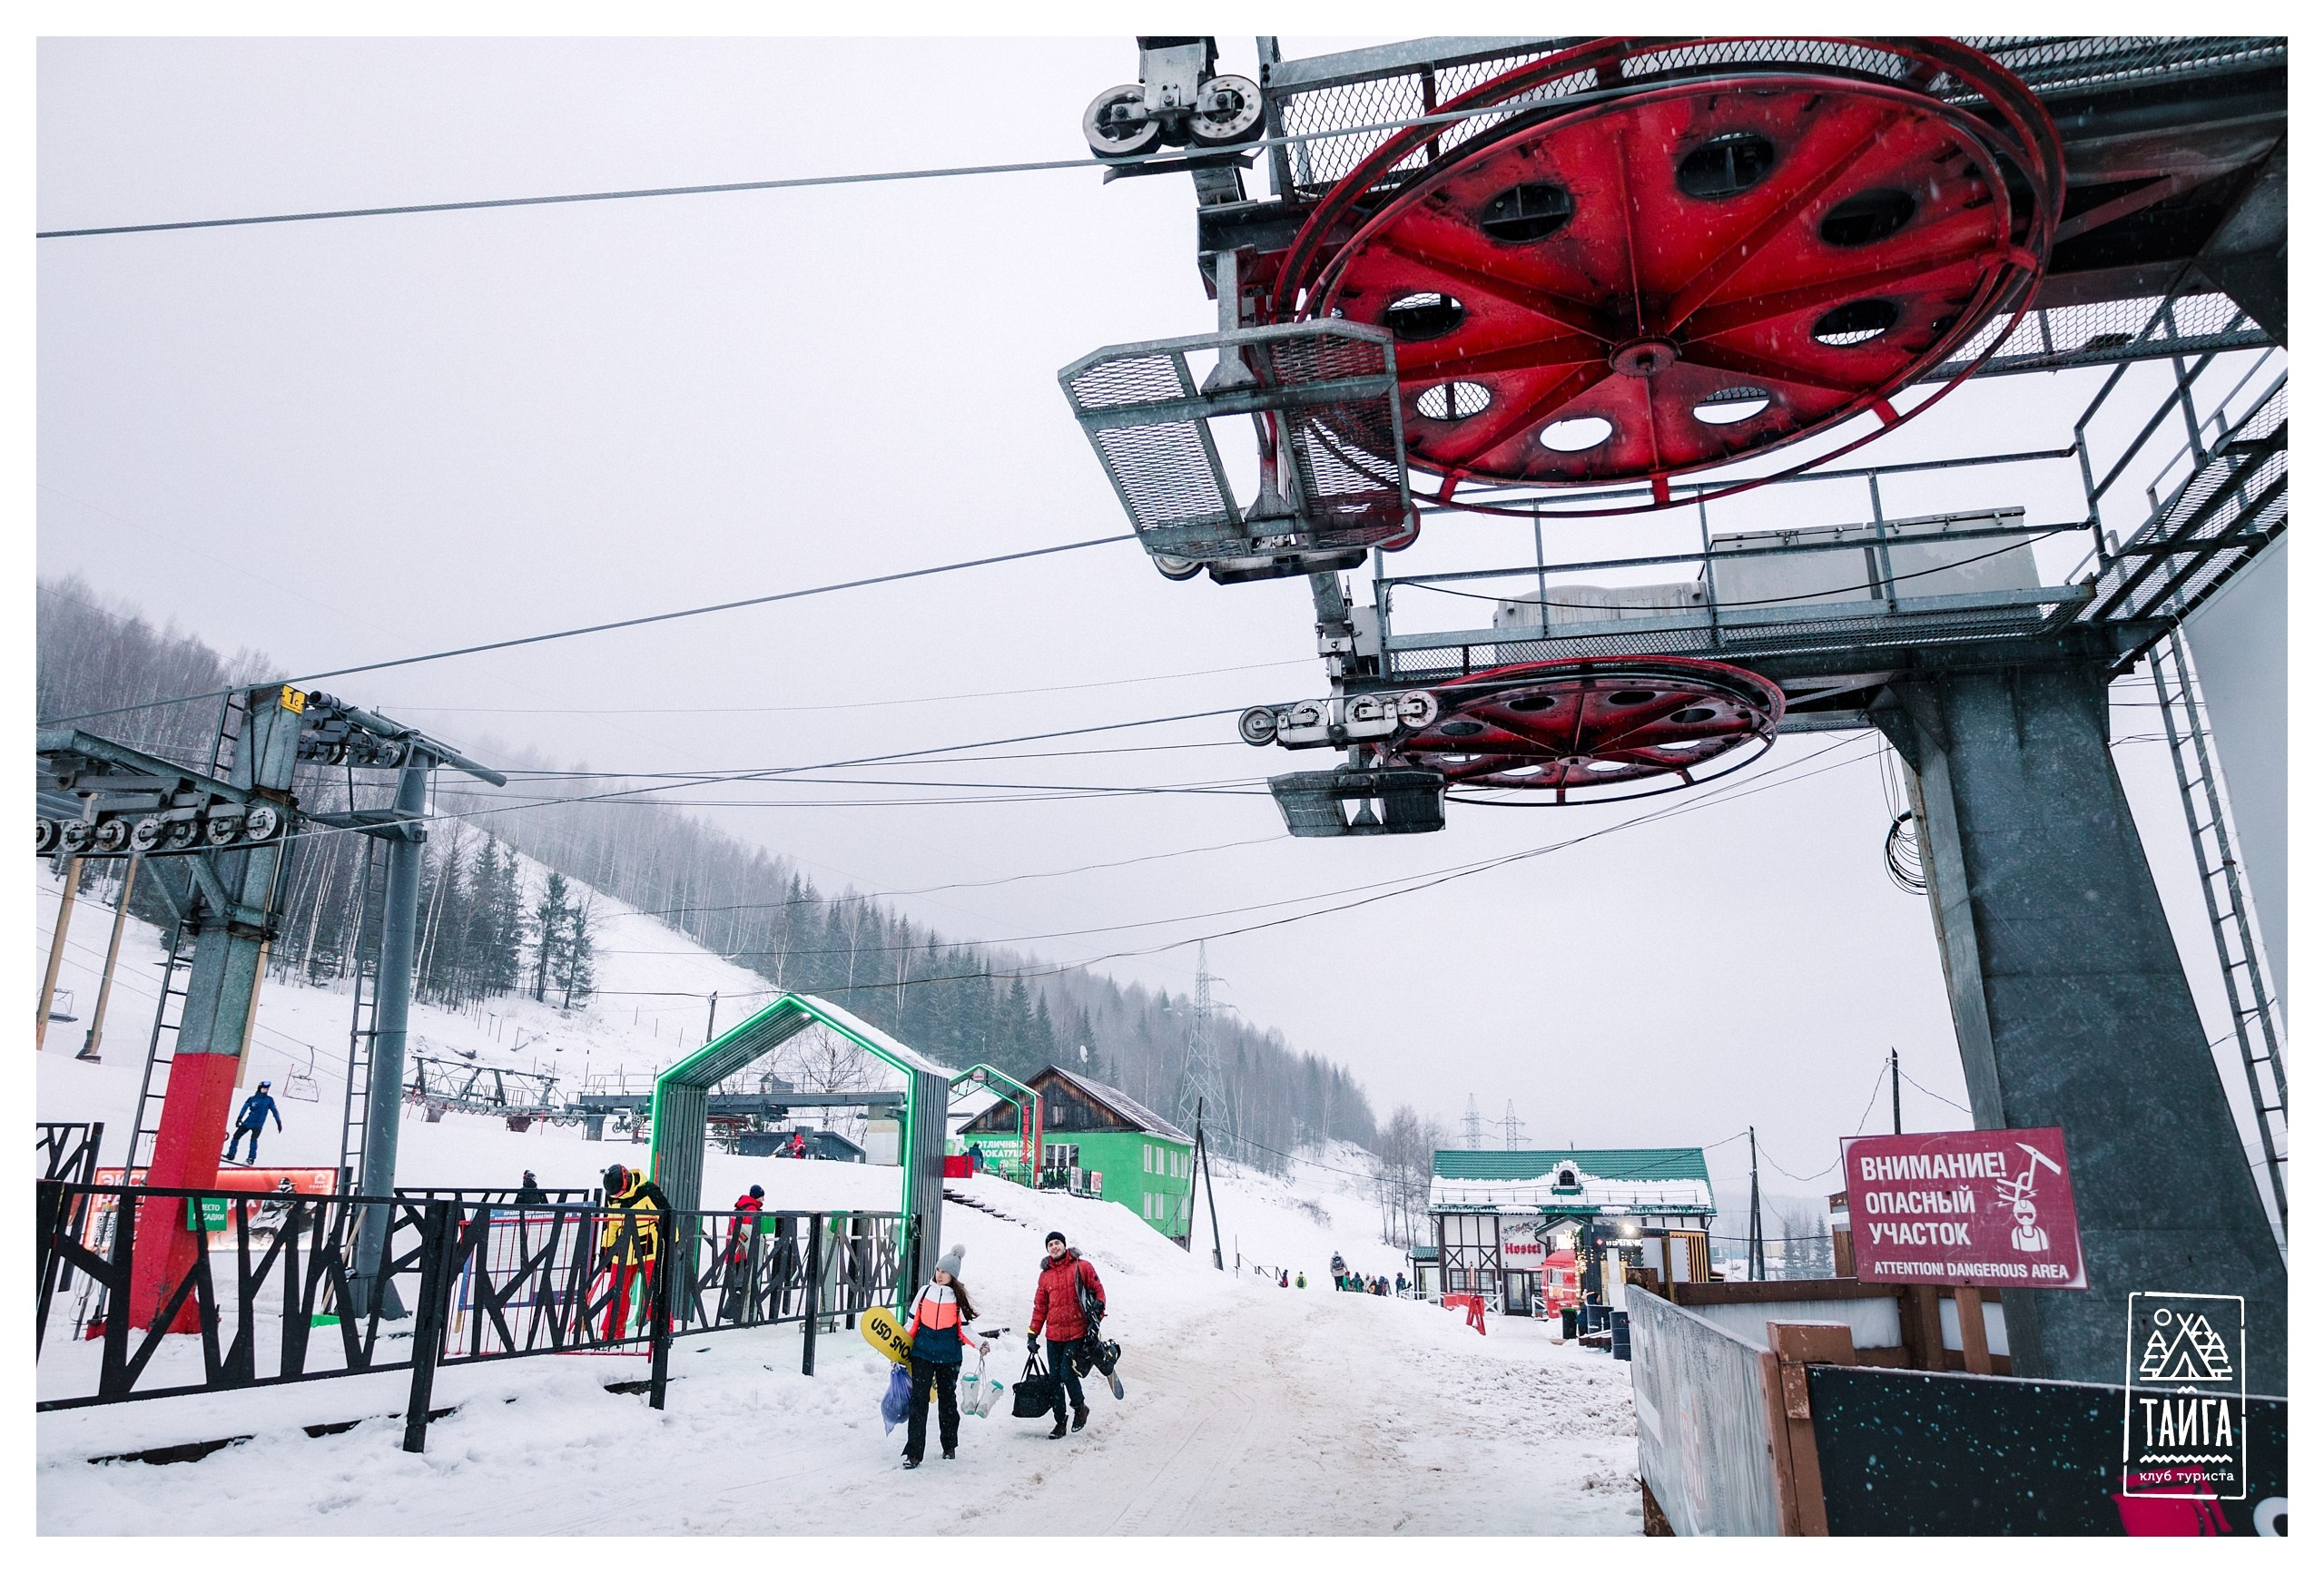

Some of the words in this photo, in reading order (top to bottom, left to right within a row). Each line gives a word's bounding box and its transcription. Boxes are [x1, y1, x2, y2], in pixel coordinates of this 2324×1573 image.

[1860, 1152, 2007, 1181] ВНИМАНИЕ!
[1865, 1185, 1975, 1214] ОПАСНЫЙ
[1868, 1223, 1972, 1246] УЧАСТОК
[1504, 1243, 1541, 1254] Hostel
[1875, 1261, 1945, 1276] ATTENTION!
[1948, 1263, 2028, 1278] DANGEROUS
[2032, 1264, 2070, 1279] AREA
[871, 1317, 892, 1341] USD
[890, 1335, 911, 1362] SNO
